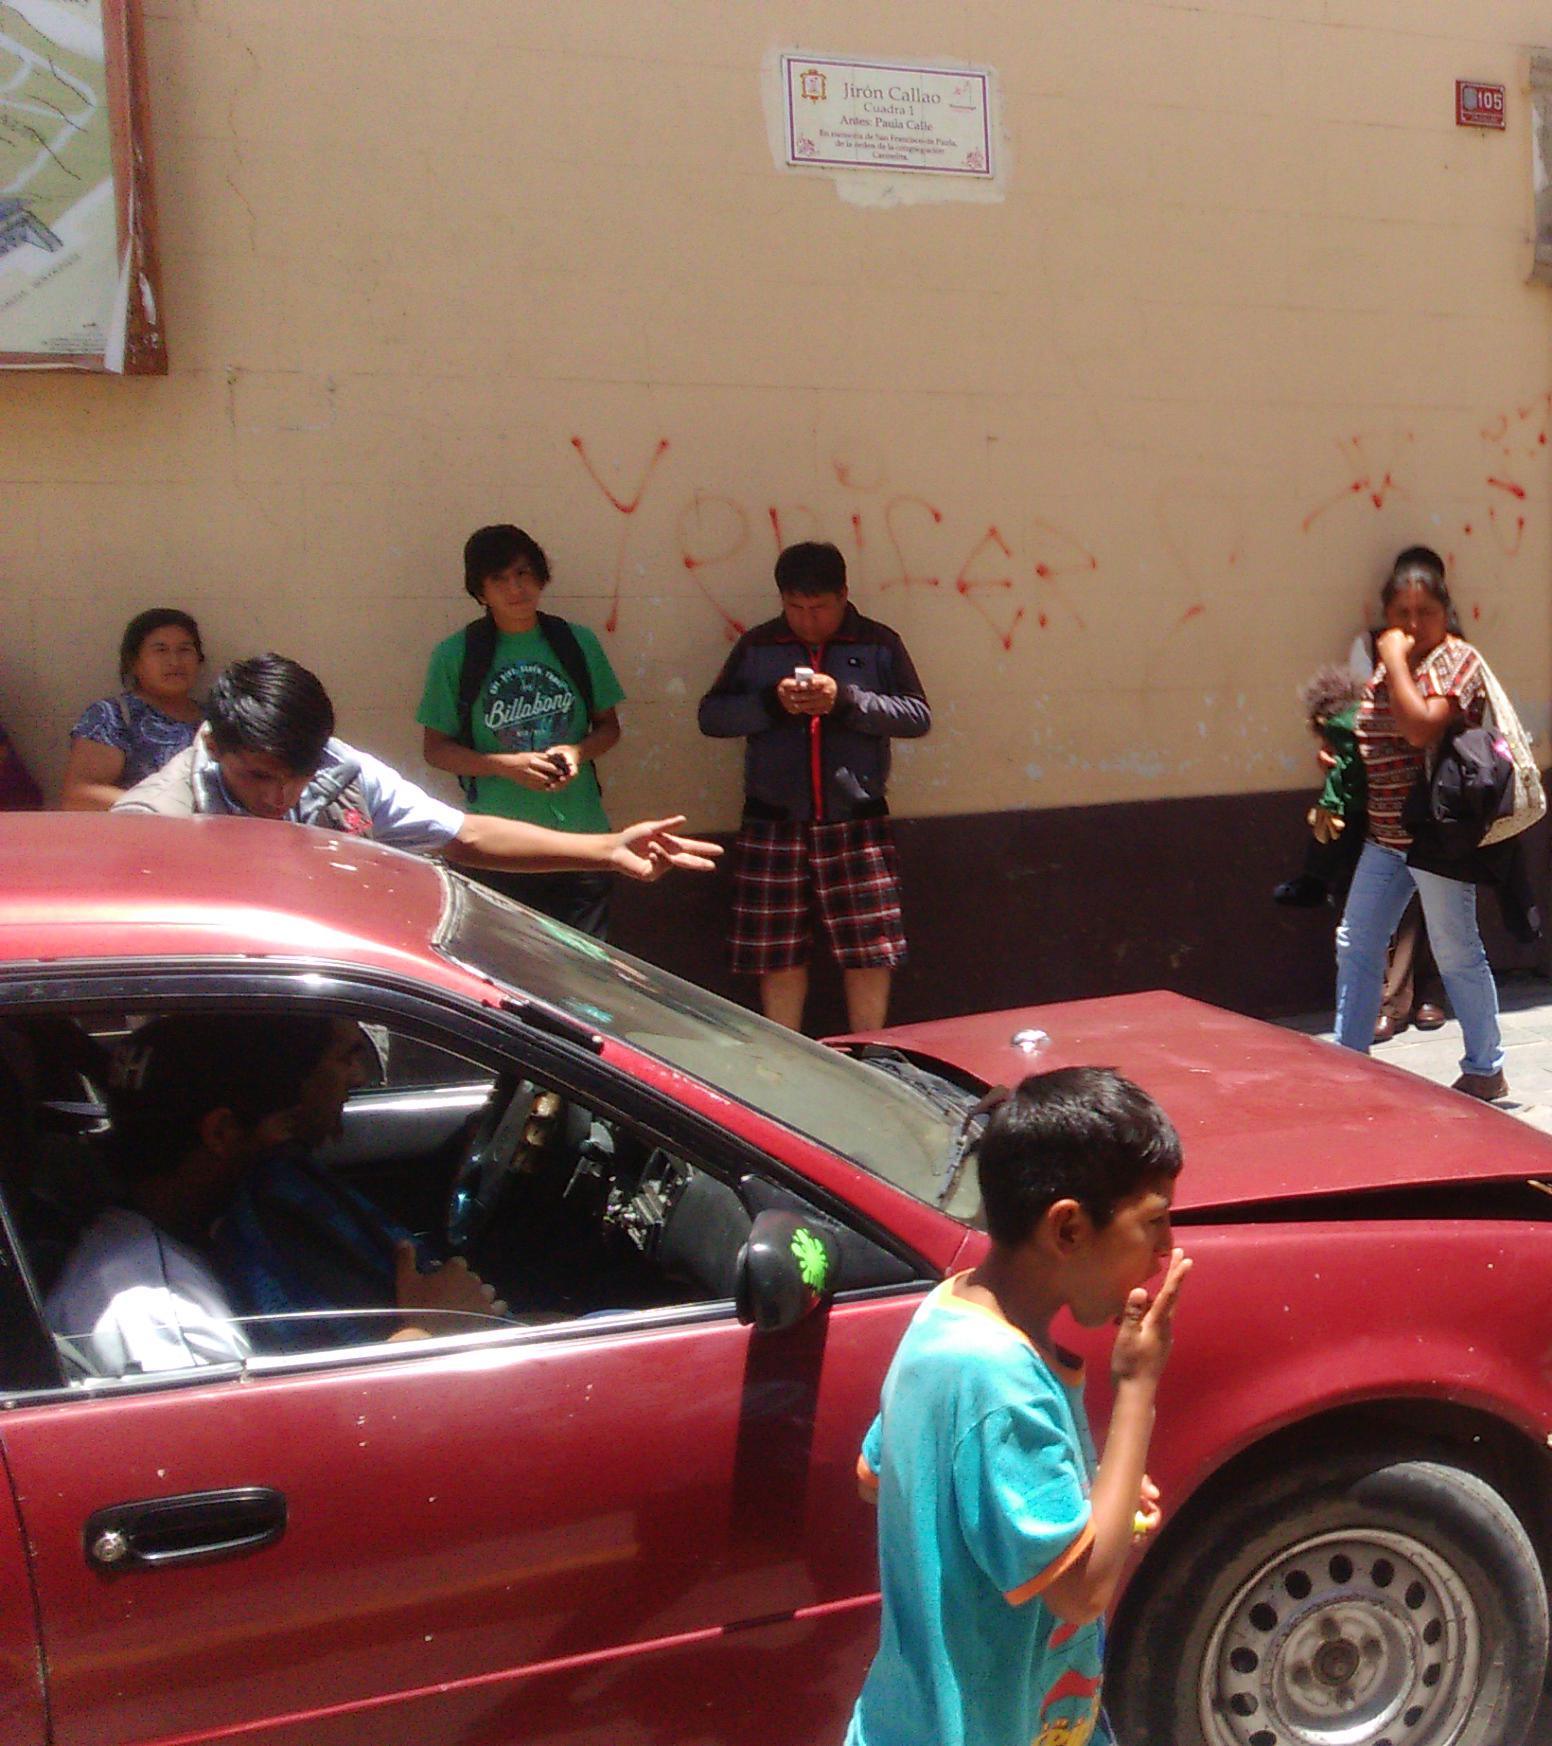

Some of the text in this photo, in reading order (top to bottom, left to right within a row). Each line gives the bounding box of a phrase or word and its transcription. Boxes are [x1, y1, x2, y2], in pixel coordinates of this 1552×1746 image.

[843, 82, 942, 104] Jirón Callao
[1478, 91, 1503, 111] 105
[863, 102, 915, 116] Cuadra 1
[875, 117, 904, 129] Paula
[906, 120, 934, 131] Calle
[485, 691, 576, 730] Billabong
